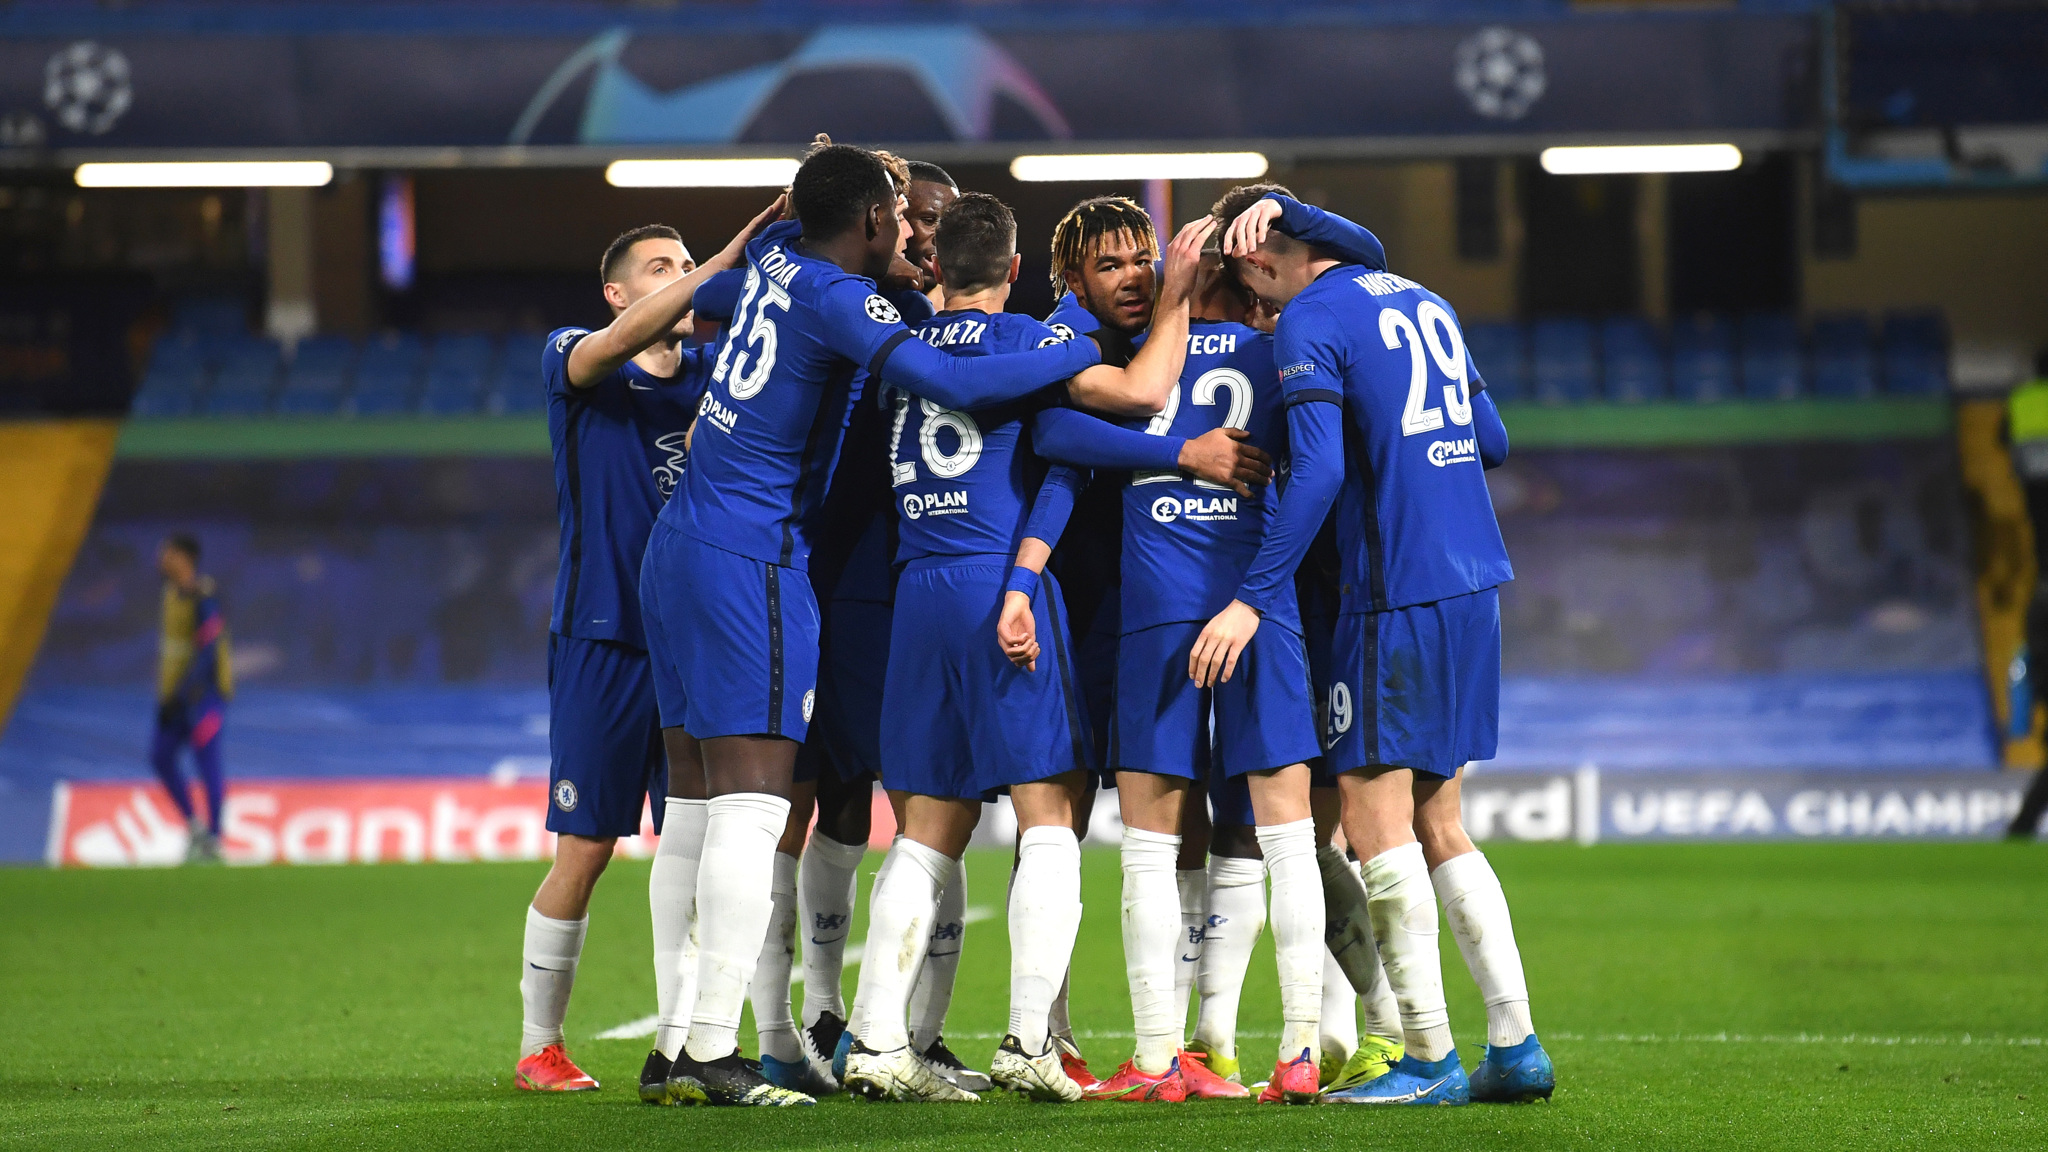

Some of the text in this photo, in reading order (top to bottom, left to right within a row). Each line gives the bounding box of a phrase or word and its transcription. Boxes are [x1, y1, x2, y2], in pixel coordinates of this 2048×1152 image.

[1187, 333, 1237, 355] ECH
[1283, 363, 1316, 377] RESPECT
[1378, 300, 1473, 437] 29
[710, 400, 738, 428] PLAN
[1444, 438, 1475, 457] PLAN
[924, 490, 968, 509] PLAN
[1184, 497, 1237, 513] PLAN
[1612, 790, 1775, 836] UEFA
[221, 791, 550, 865] Santa
